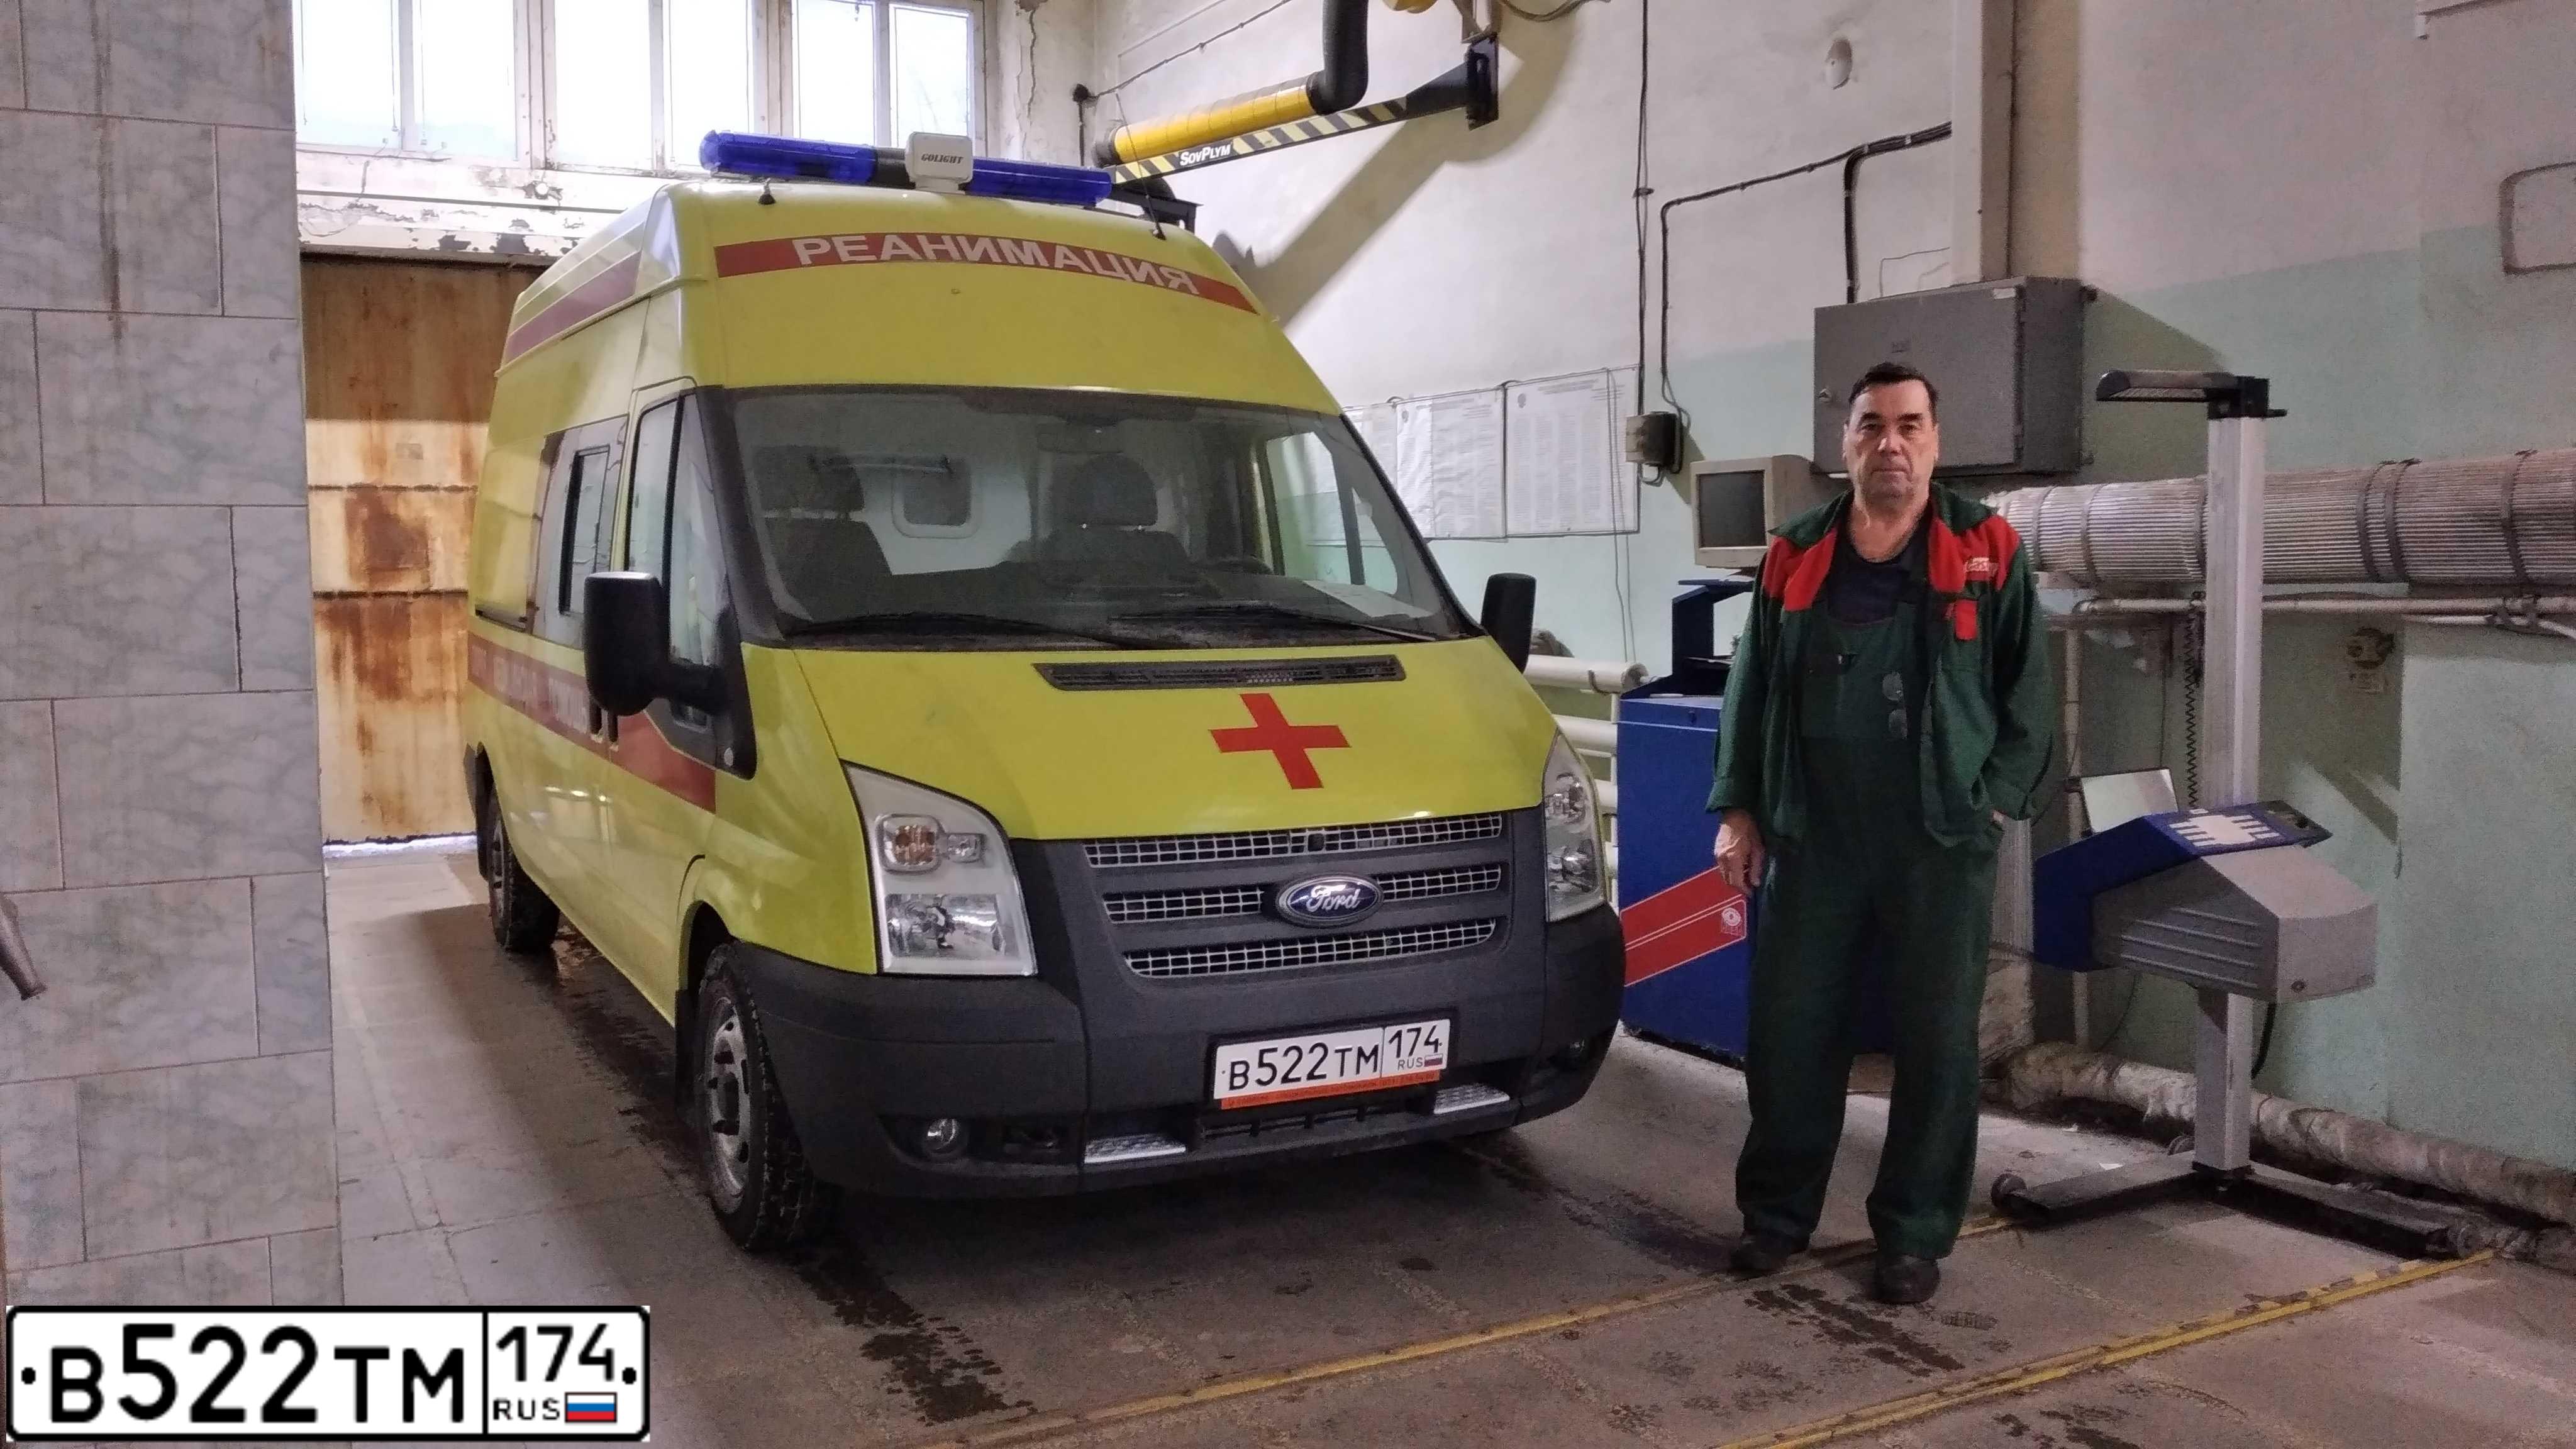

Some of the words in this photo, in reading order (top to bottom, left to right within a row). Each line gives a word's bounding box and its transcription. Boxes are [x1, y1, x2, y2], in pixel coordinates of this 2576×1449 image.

[921, 153, 963, 164] GOLIGHT
[792, 234, 1199, 295] РЕАНИМАЦИЯ
[1306, 884, 1362, 913] Ford
[1388, 1024, 1440, 1058] 174
[1397, 1056, 1424, 1070] RUS
